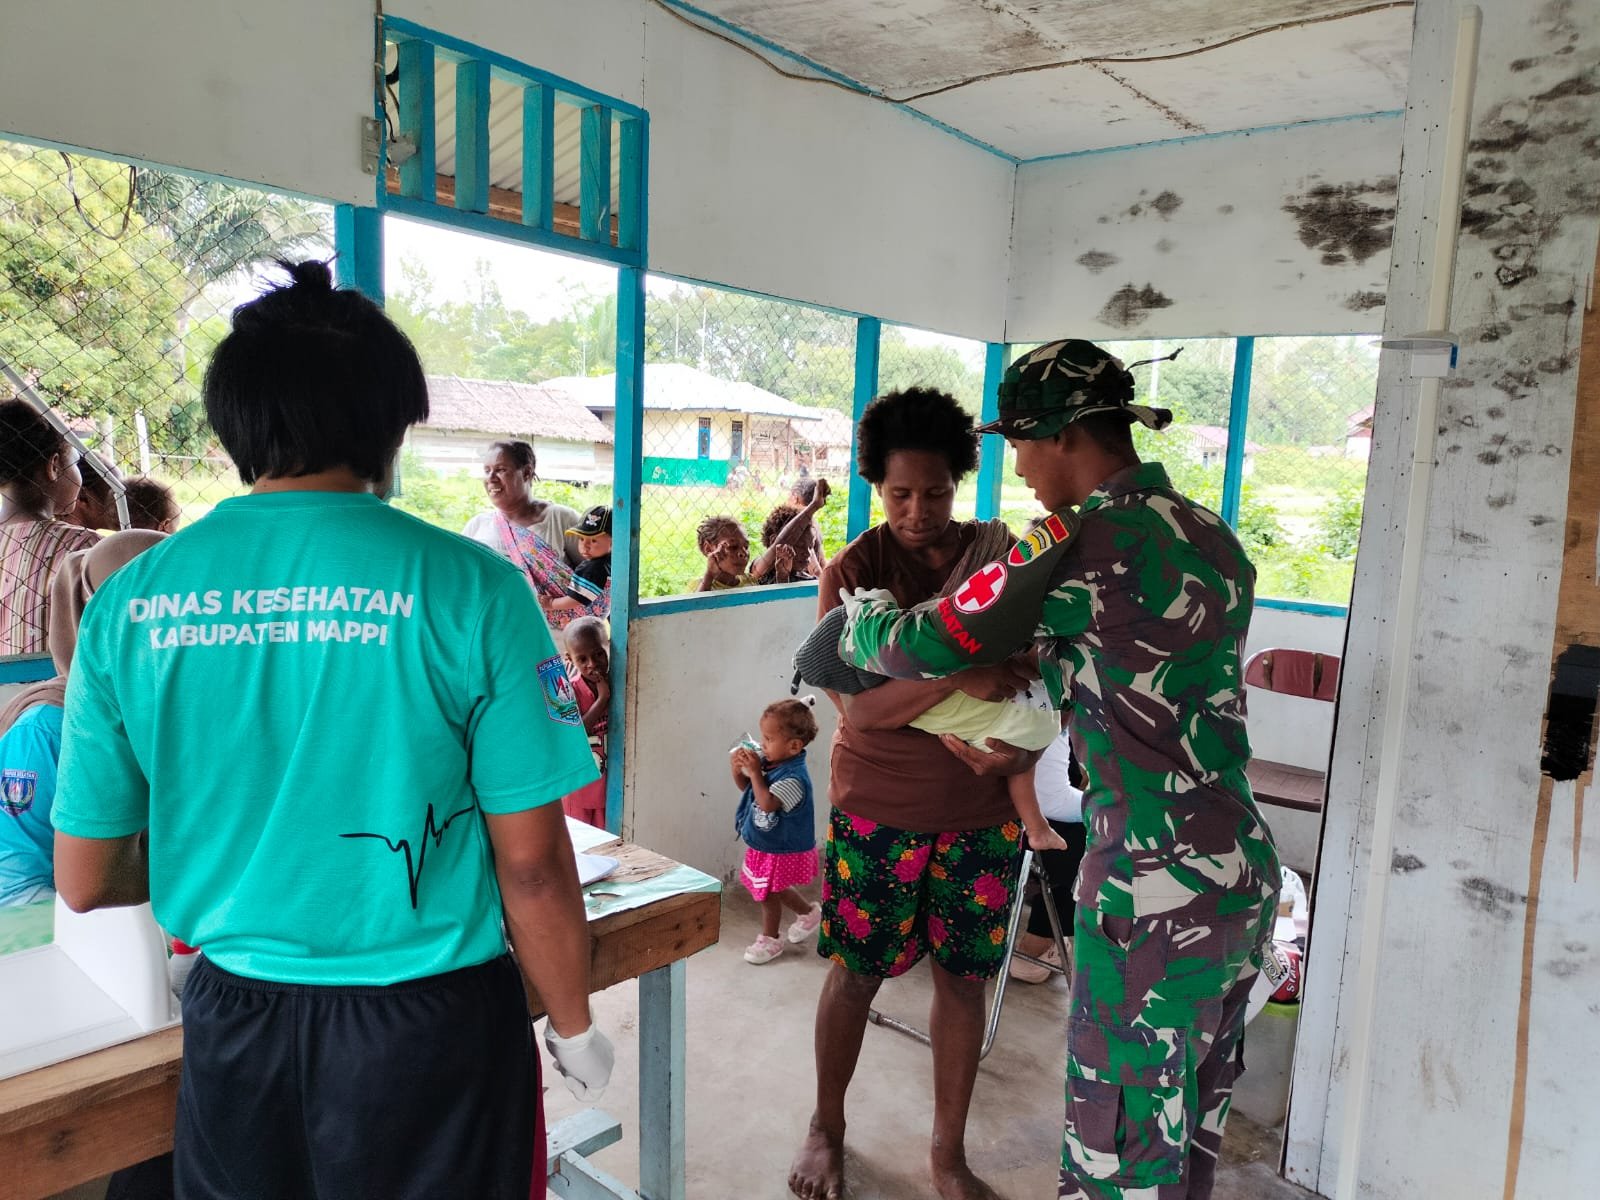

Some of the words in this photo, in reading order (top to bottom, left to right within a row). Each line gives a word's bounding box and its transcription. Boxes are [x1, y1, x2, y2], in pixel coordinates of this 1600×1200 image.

[128, 590, 222, 623] DINAS
[232, 586, 414, 618] KESEHATAN
[150, 622, 299, 650] KABUPATEN
[307, 620, 388, 646] MAPPI
